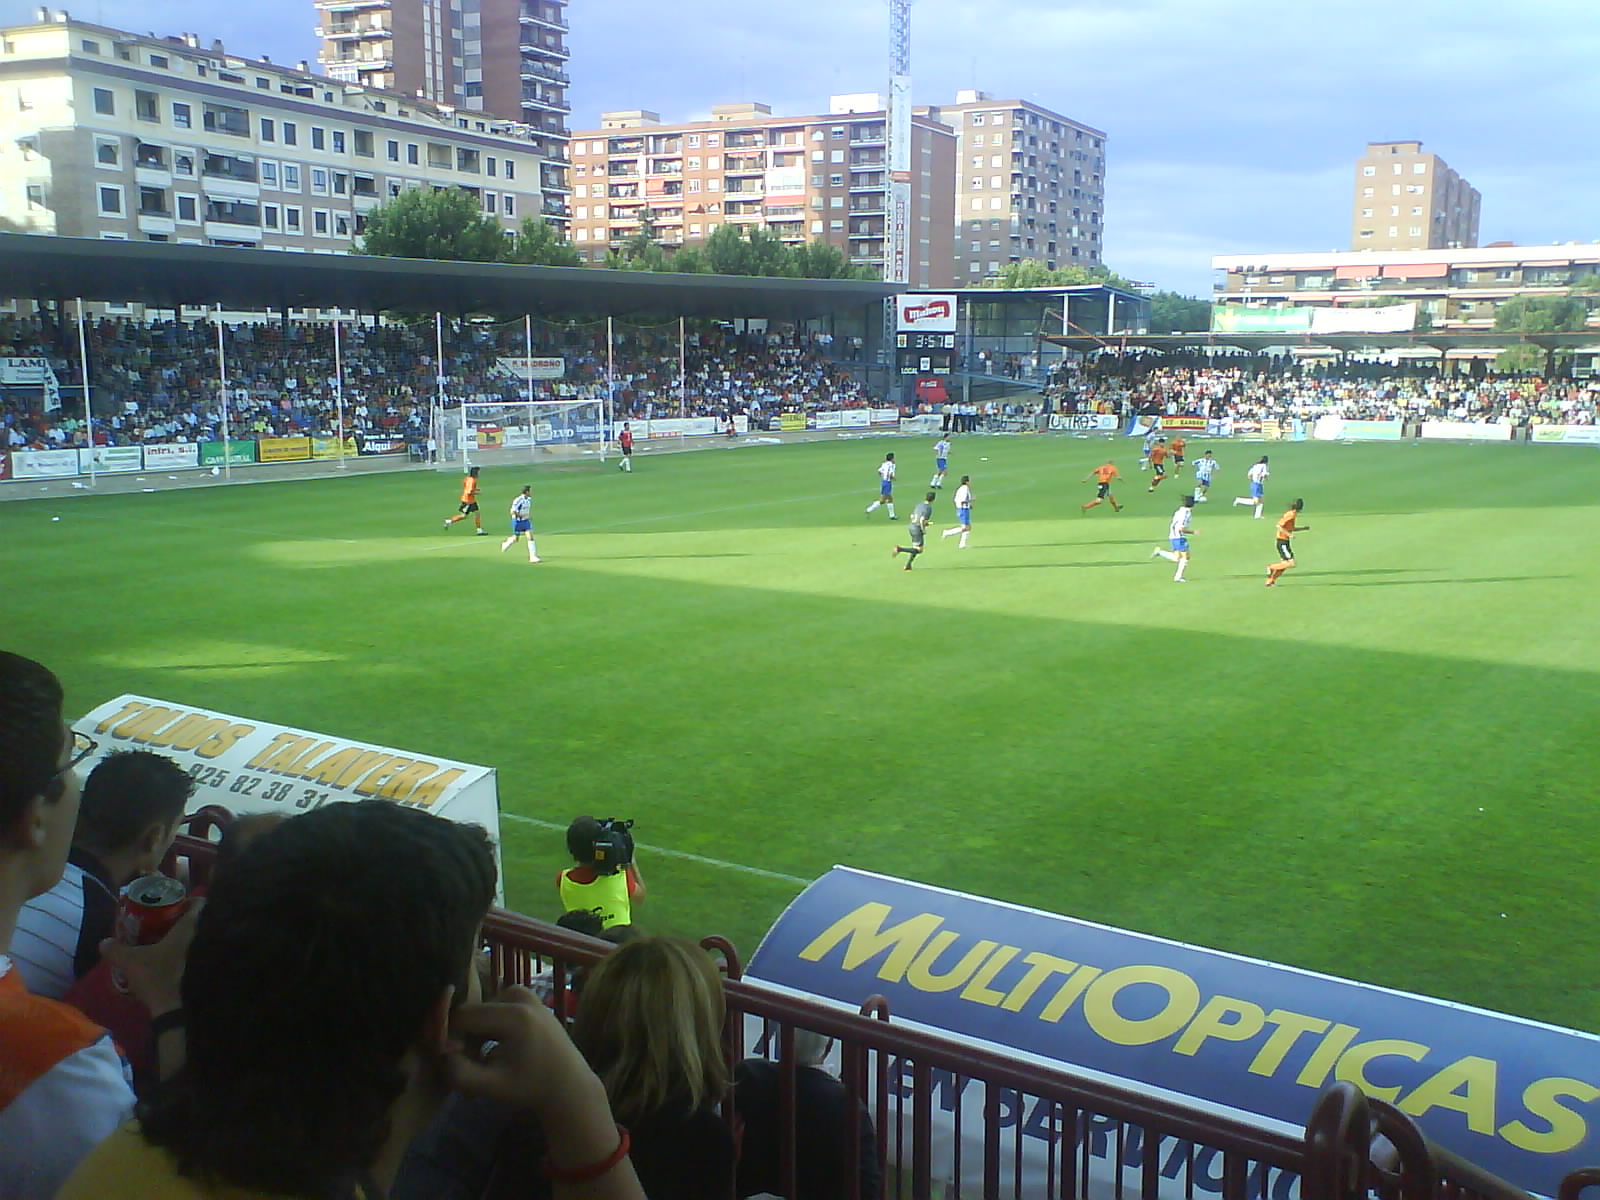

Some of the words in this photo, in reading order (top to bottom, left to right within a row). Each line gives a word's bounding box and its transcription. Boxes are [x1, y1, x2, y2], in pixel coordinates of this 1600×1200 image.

[94, 700, 257, 760] TOLDOS
[243, 731, 467, 809] TALAVERA
[188, 763, 230, 789] 925
[229, 774, 262, 796] 82
[295, 788, 329, 810] 31
